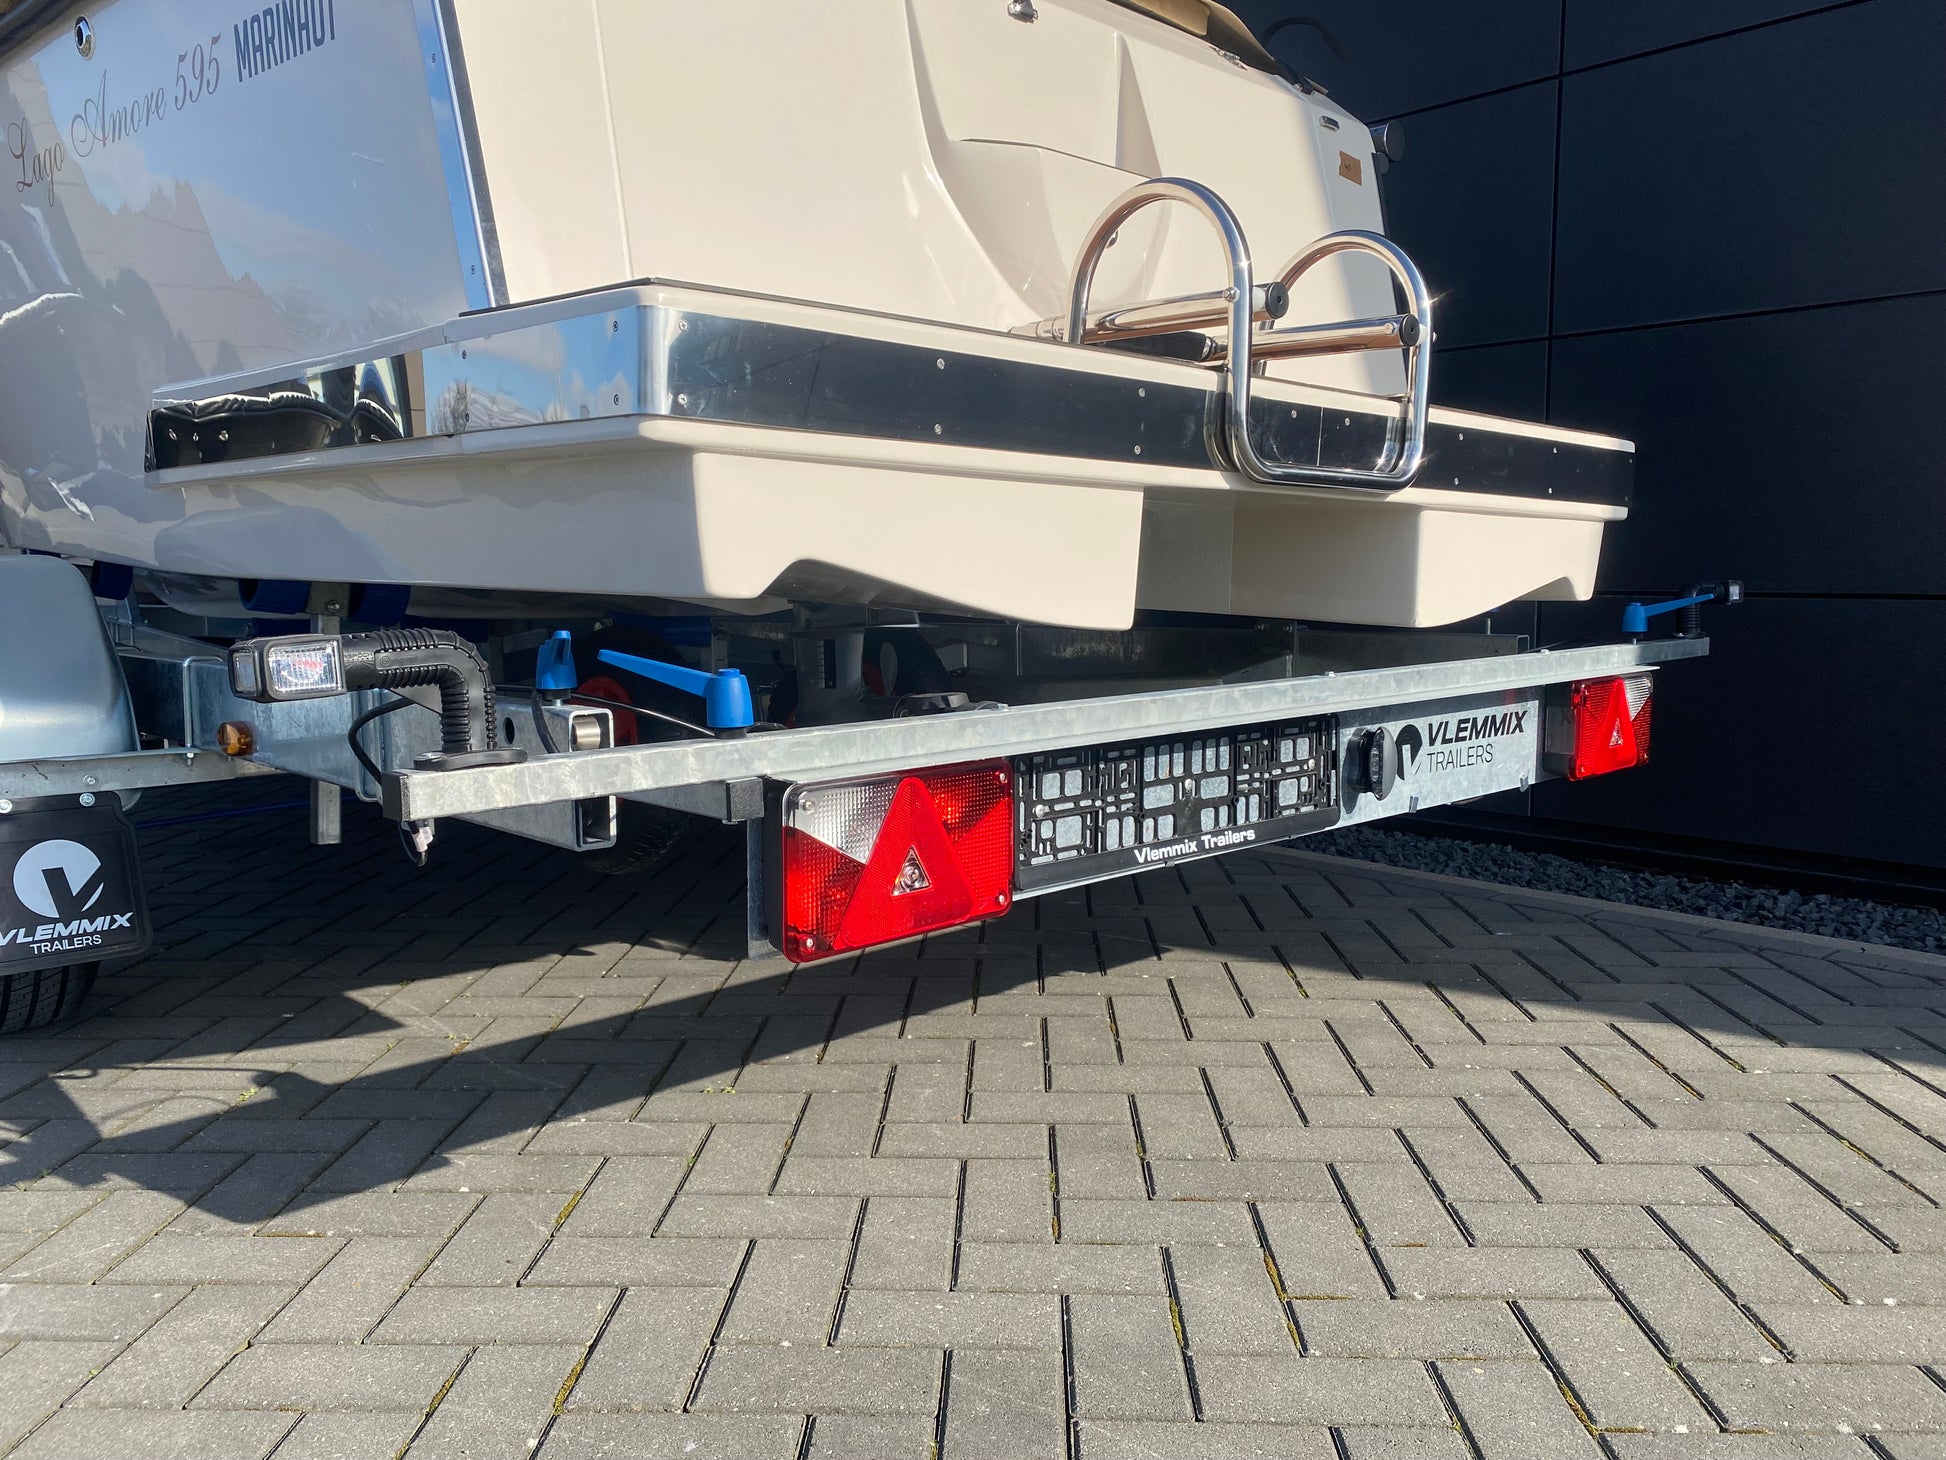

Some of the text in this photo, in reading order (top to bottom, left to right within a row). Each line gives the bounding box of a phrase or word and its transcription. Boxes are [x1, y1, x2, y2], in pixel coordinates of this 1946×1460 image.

[8, 33, 221, 207] Lago Amore 595
[1428, 710, 1528, 747] VLEMMIX
[1427, 743, 1494, 773] TRAILERS
[1134, 829, 1256, 863] Vlemmix Trailers
[0, 912, 133, 946] VLEMMIX
[30, 934, 102, 954] TRAILERS
